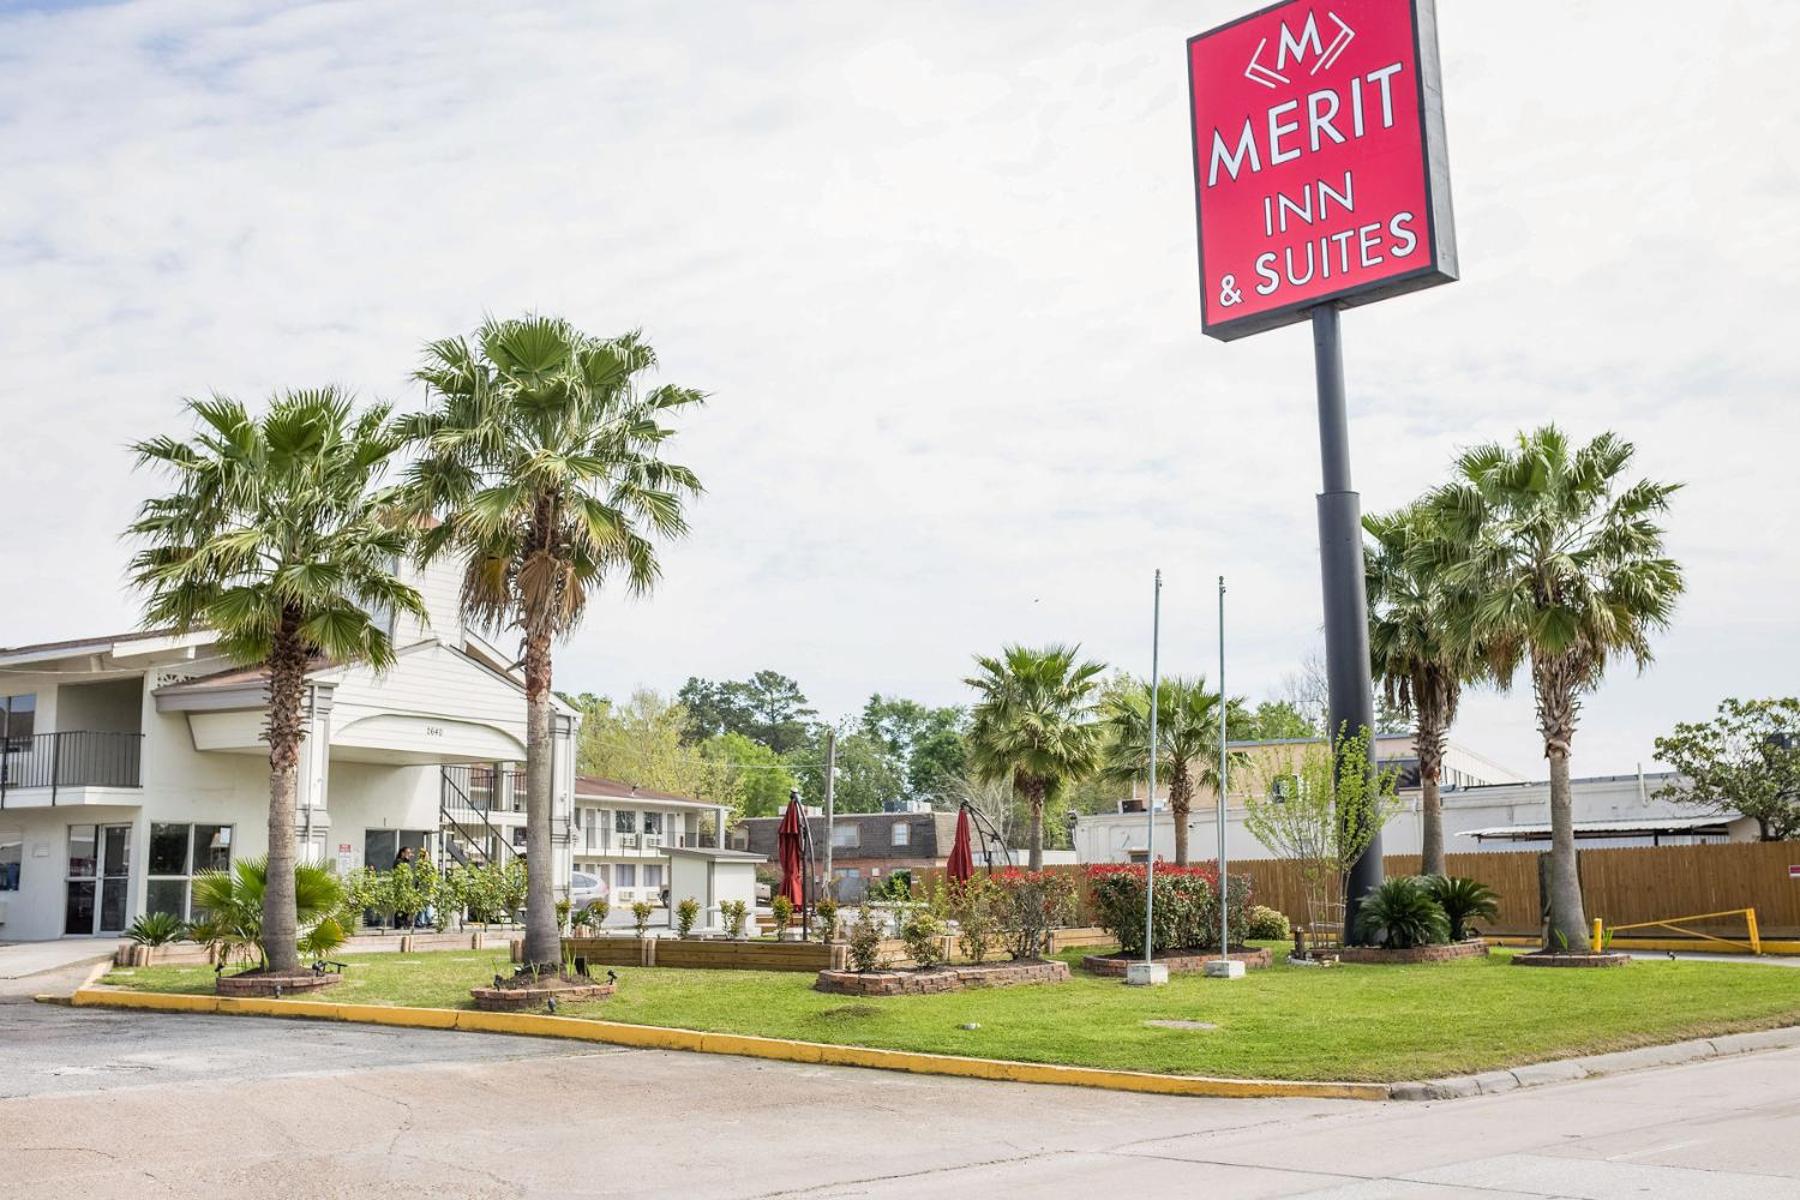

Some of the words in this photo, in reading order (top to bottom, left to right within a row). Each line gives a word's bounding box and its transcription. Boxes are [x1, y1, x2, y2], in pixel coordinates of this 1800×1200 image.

[1277, 10, 1323, 71] M
[1207, 62, 1403, 187] MERIT
[1264, 171, 1355, 237] INN
[1219, 273, 1244, 307] &
[1255, 211, 1418, 296] SUITES
